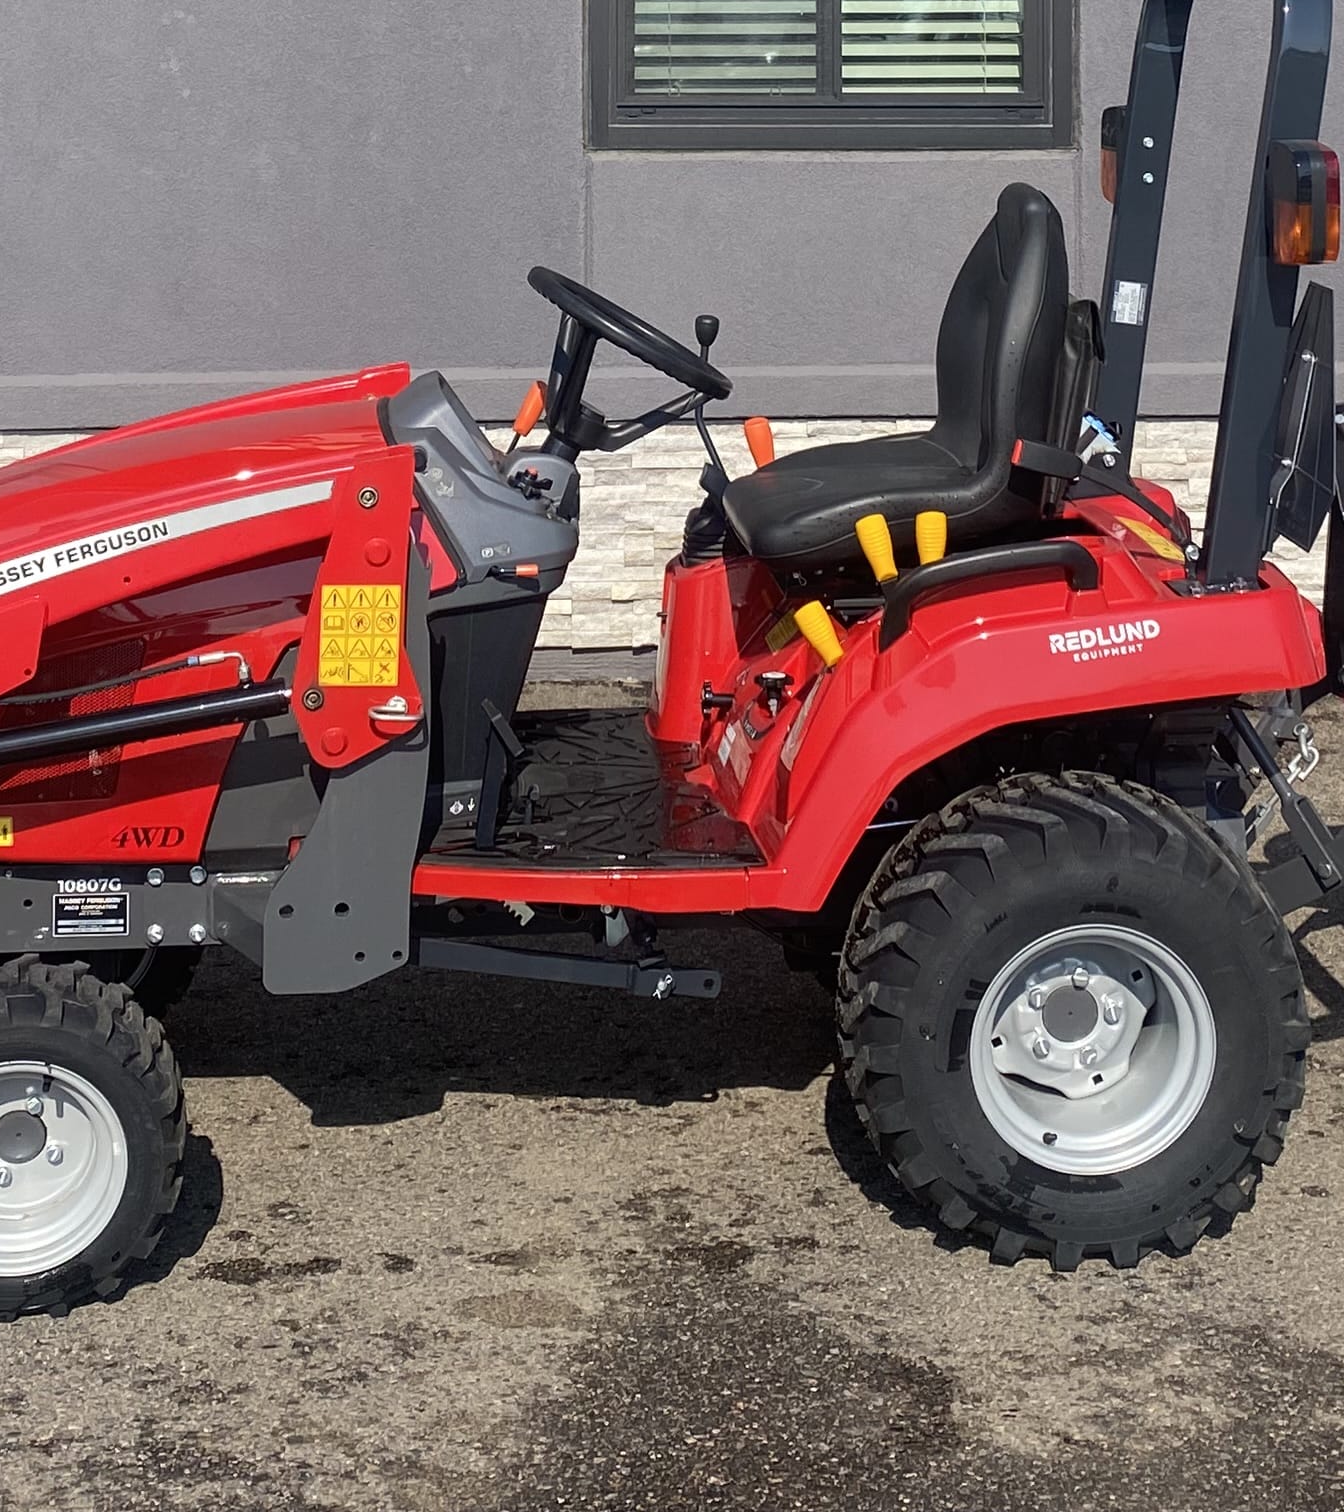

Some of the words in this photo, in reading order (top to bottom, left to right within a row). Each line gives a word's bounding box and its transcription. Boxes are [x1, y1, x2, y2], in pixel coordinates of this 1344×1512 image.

[54, 521, 169, 567] FERGUSON
[1049, 619, 1160, 654] REDLUND
[1073, 644, 1143, 662] EQUIPMENT
[111, 826, 185, 848] 4WD
[57, 878, 121, 893] 10807G
